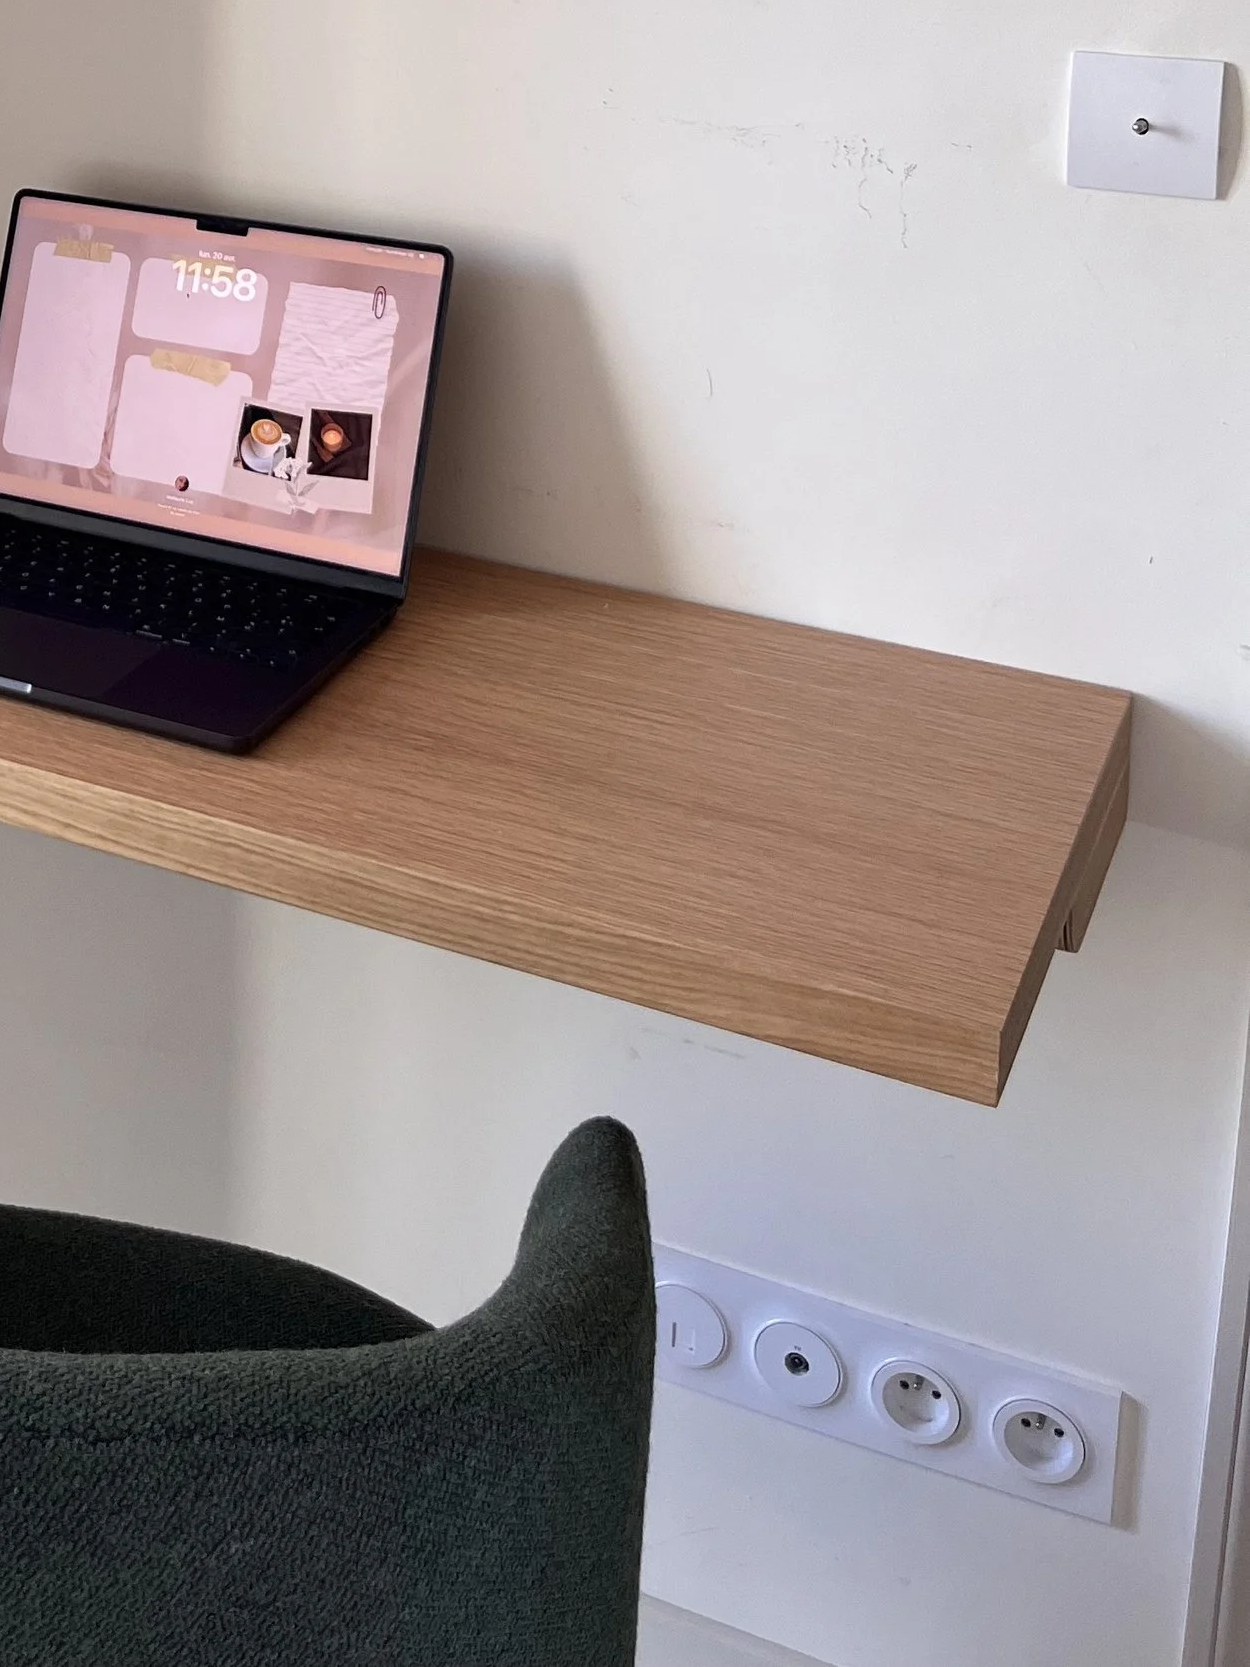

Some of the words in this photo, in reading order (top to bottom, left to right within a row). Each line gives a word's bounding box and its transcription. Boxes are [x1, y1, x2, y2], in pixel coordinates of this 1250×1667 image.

[198, 250, 211, 259] lun.
[212, 251, 223, 260] 20
[172, 259, 258, 302] 11:58
